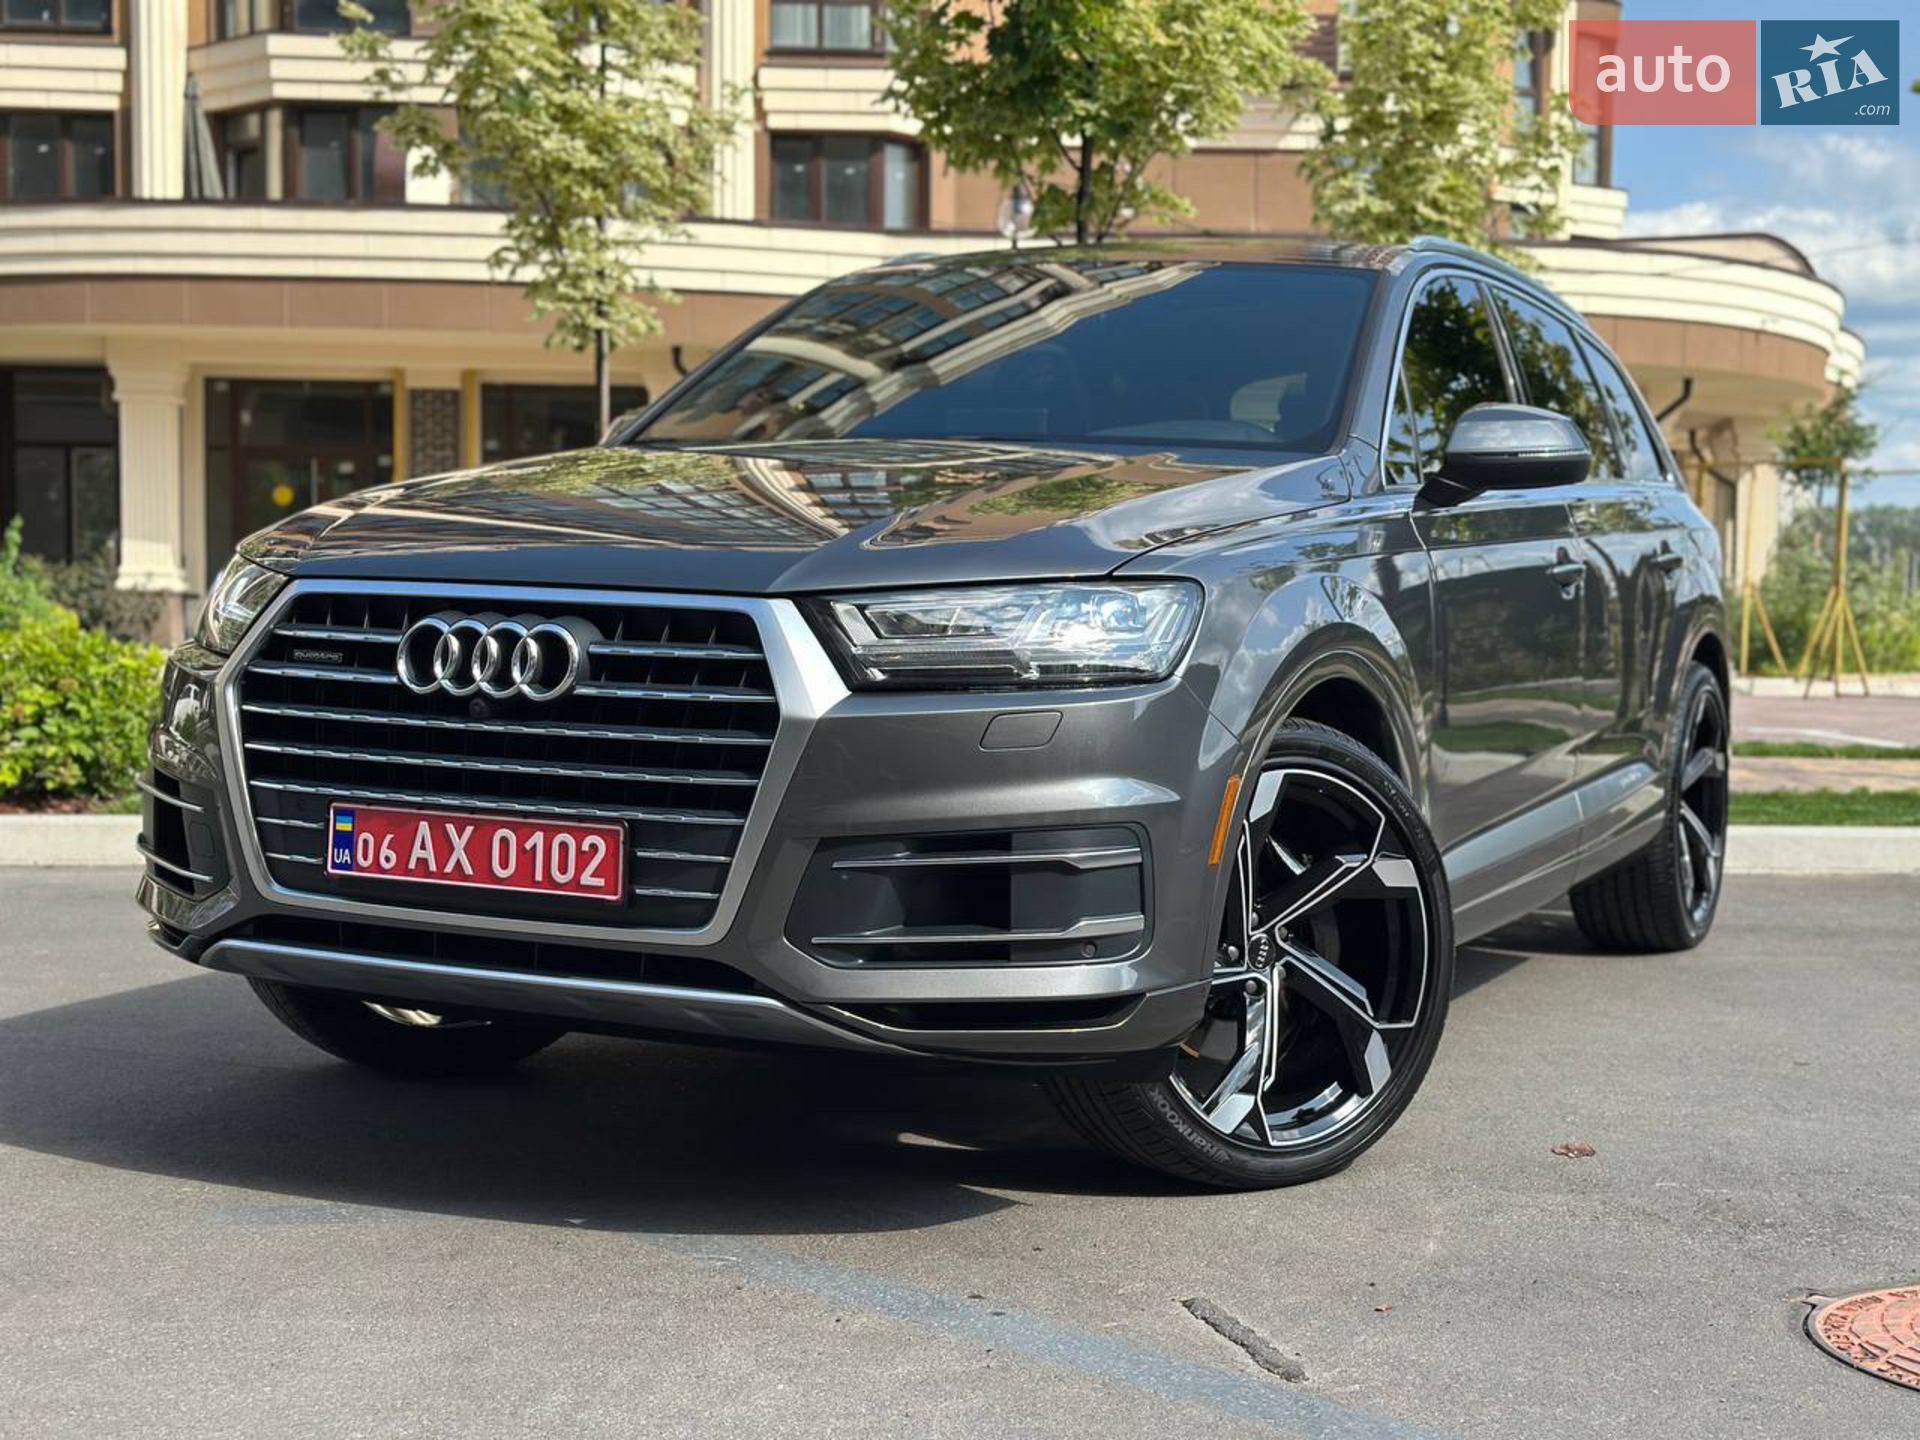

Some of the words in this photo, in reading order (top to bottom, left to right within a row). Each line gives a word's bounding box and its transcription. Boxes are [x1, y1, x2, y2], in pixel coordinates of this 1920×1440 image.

[333, 847, 351, 865] UA
[356, 832, 397, 870] 06
[408, 821, 475, 875] AX
[491, 827, 607, 887] 0102
